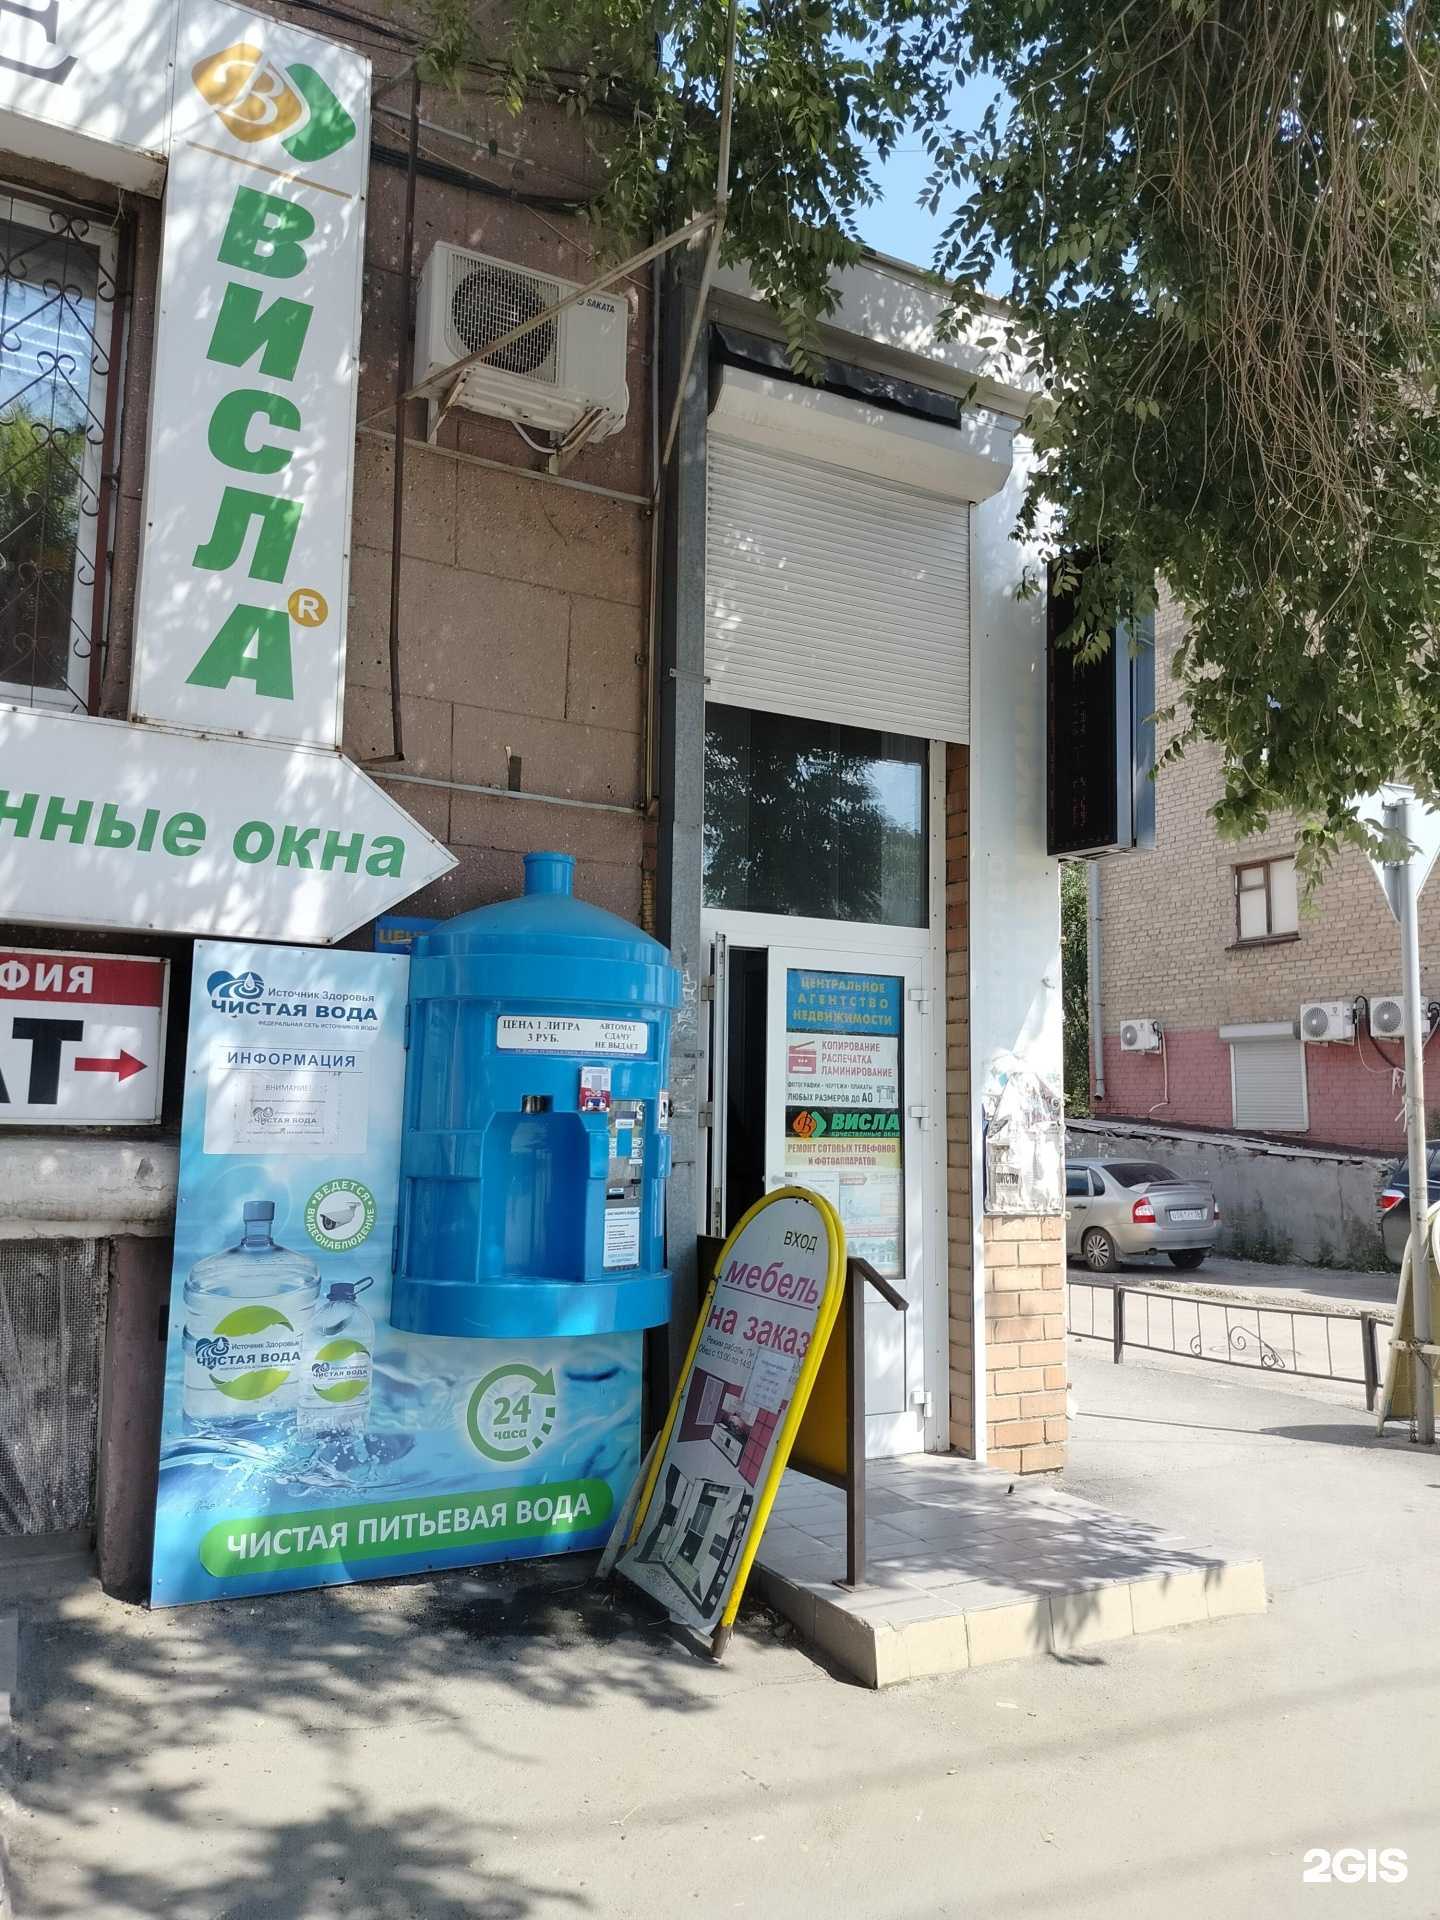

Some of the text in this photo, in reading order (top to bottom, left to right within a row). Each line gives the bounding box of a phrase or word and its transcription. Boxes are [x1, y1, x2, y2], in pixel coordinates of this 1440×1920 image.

[587, 298, 615, 312] SAKATA
[186, 185, 315, 700] ВИСЛА
[0, 789, 406, 879] нные окна
[0, 960, 93, 994] ФИЯ
[801, 977, 885, 993] ЦЕНТРАЛЬНОЕ
[268, 987, 374, 1003] Источник Здоровья
[798, 993, 889, 1008] АГЕНТСТВО
[211, 1000, 378, 1022] ЧИСТАЯ ВОДА
[793, 1009, 892, 1026] НЕДВИЖИМОСТИ
[503, 1020, 580, 1031] ЦЕНА 1 ЛИТРА
[600, 1023, 636, 1031] АВТОМАТ
[527, 1033, 559, 1043] 3 РУБ.
[604, 1032, 631, 1041] СДАЧУ
[608, 1042, 639, 1050] ВЫДАЕТ
[821, 1041, 881, 1052] КОПИРОВАНИЕ
[0, 1017, 84, 1105] Т
[227, 1052, 356, 1068] ИНФОРМАЦИЯ
[821, 1053, 872, 1064] РАСПЕЧАТКА
[821, 1066, 893, 1077] ЛАМИНИРОВАНИЕ
[787, 1092, 814, 1102] ЛЮБЫХ
[815, 1093, 850, 1103] РАЗМЕРОВ
[831, 1113, 900, 1130] ВИСЛА
[788, 1143, 896, 1153] РЕМОНТ СОТОВЫХ ТЕЛЕФОНОВ
[814, 1157, 876, 1166] ФОТОАППАРАТОВ
[314, 1180, 370, 1201] ВЕДЕТСЯ
[306, 1207, 375, 1250] ВИДЕОНАБЛЮДЕНИЕ
[783, 1230, 818, 1252] ВХОД
[724, 1260, 819, 1304] мебель
[707, 1305, 738, 1335] на
[197, 1353, 256, 1367] ЧИСТАЯ
[261, 1351, 301, 1363] ВОДА
[493, 1394, 532, 1426] 24
[493, 1427, 528, 1441] часа
[227, 1492, 591, 1560] ЧИСТАЯ ПИТЬЕВАЯ ВОДА
